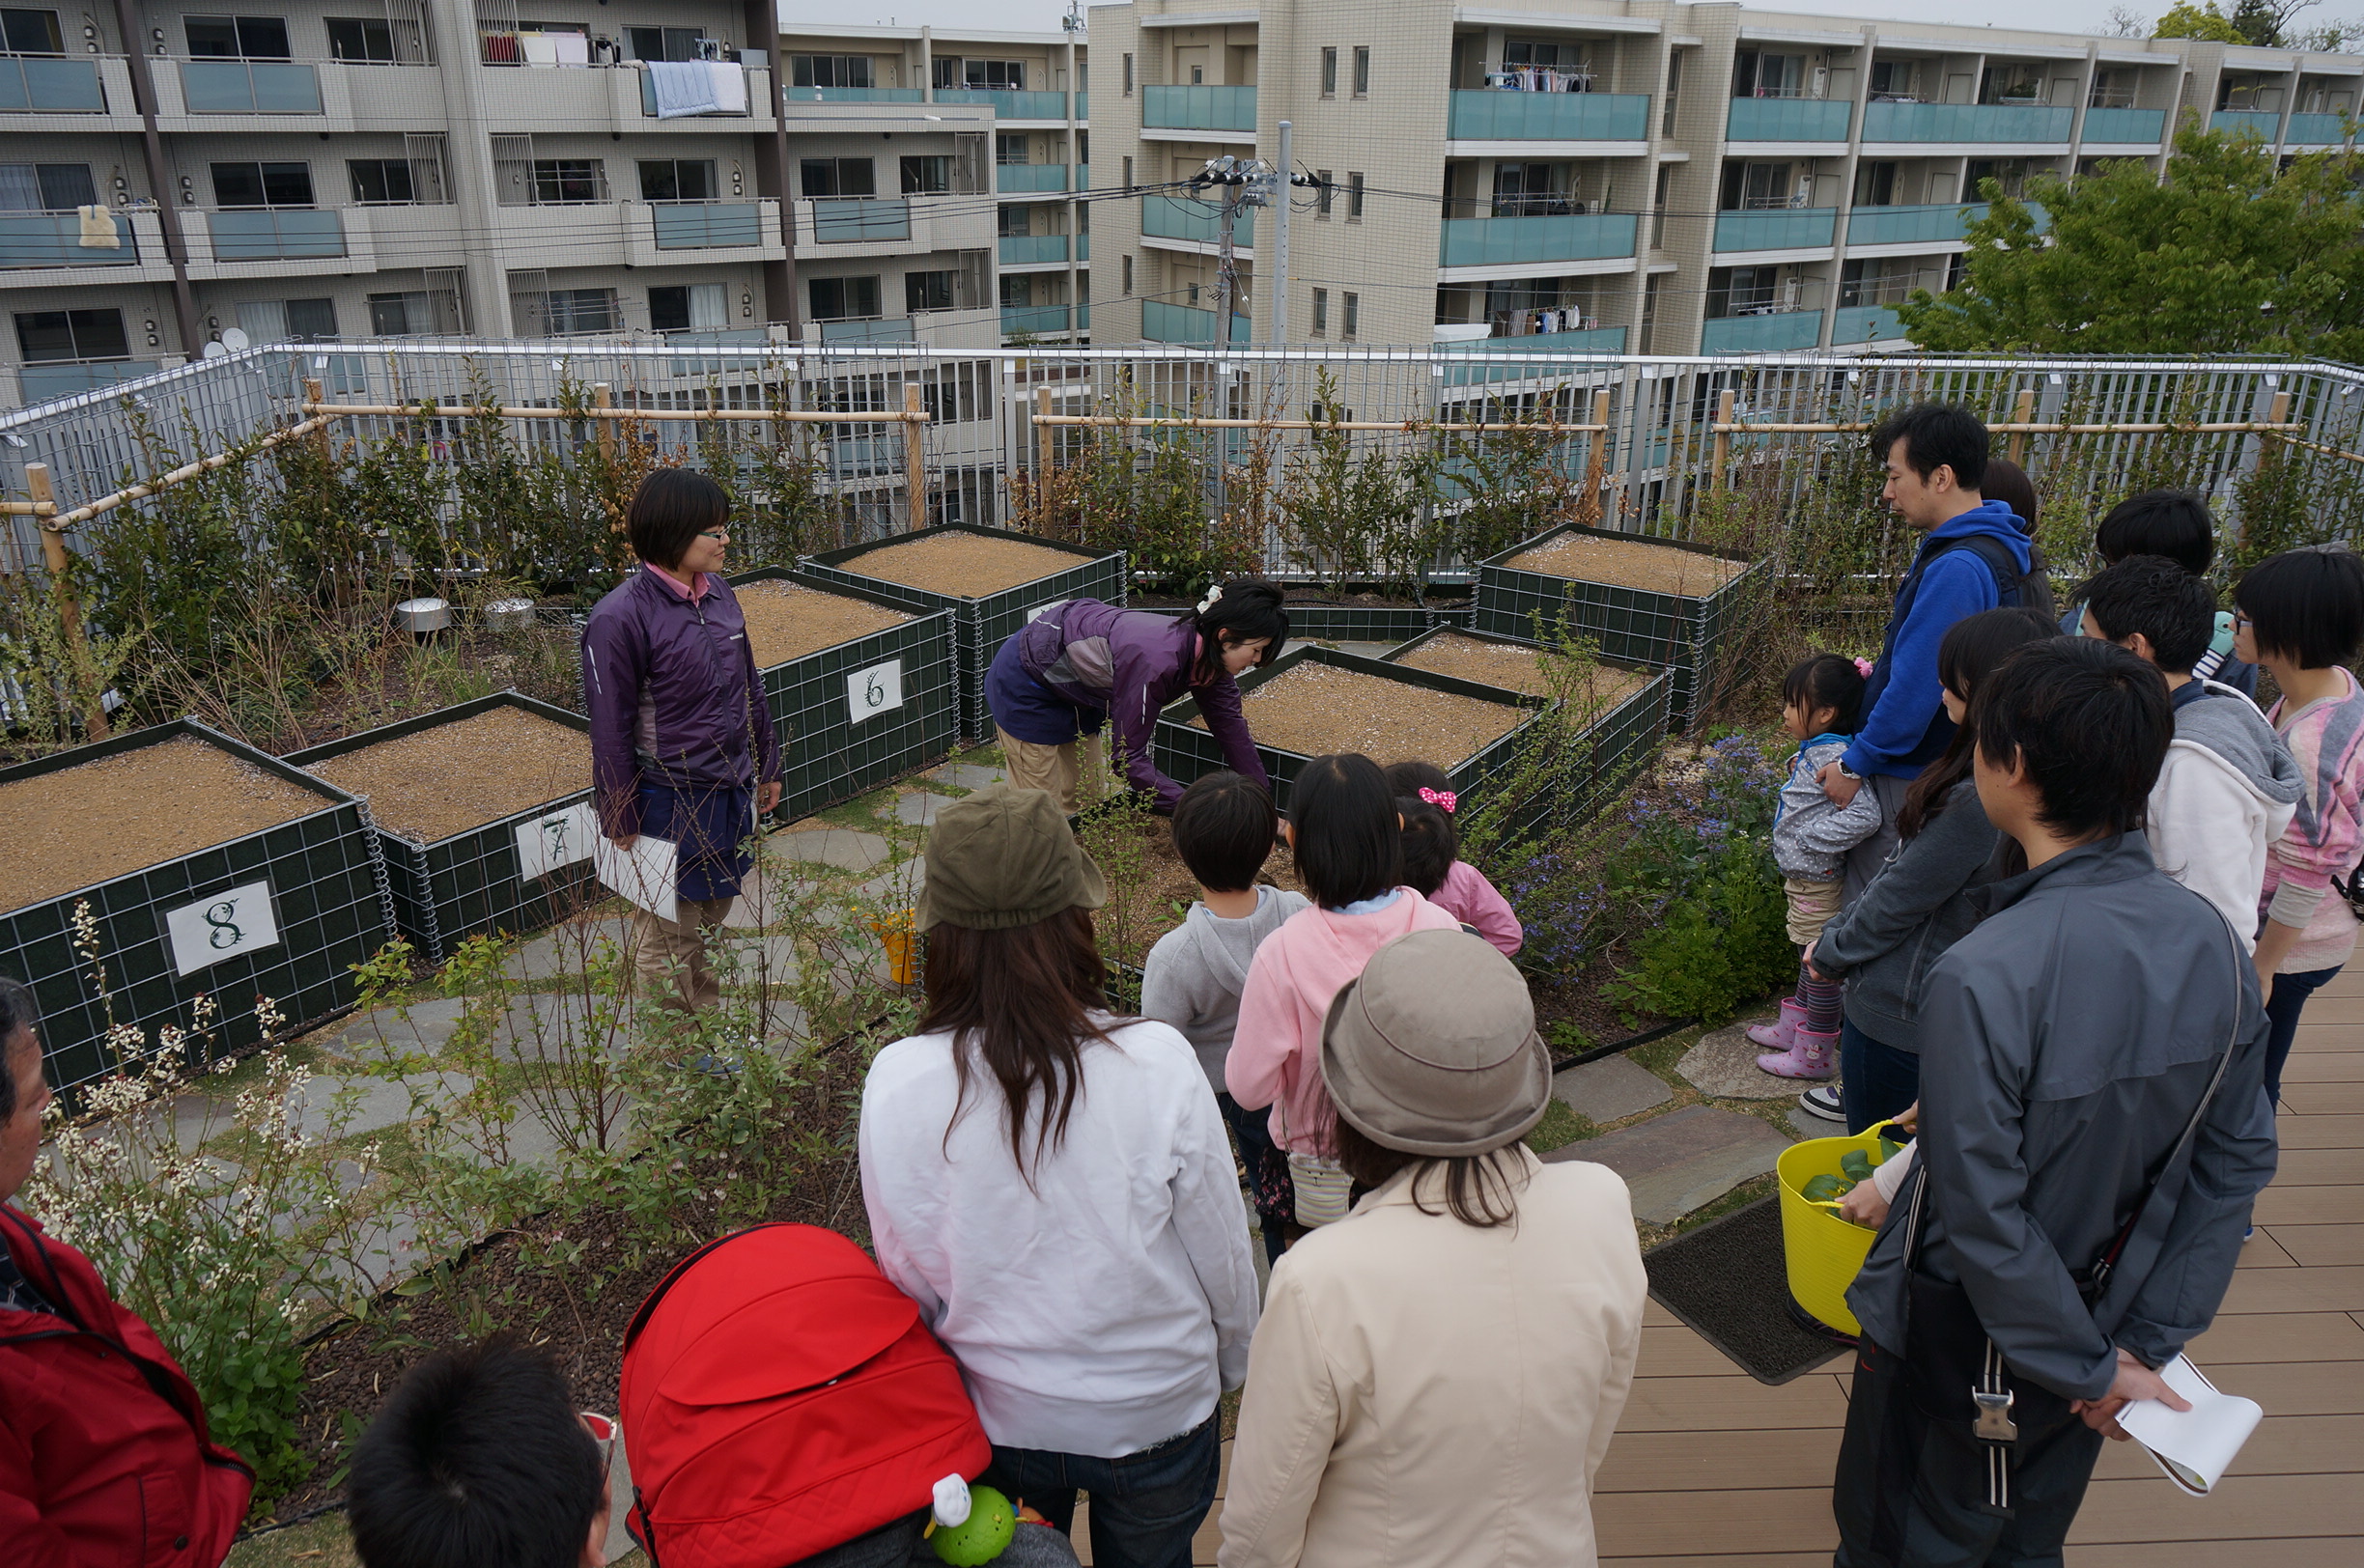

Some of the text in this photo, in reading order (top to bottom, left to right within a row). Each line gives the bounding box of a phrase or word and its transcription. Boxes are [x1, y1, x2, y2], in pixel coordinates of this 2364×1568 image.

[864, 670, 885, 708] 6
[543, 816, 570, 862] 7
[204, 898, 244, 949] 8
